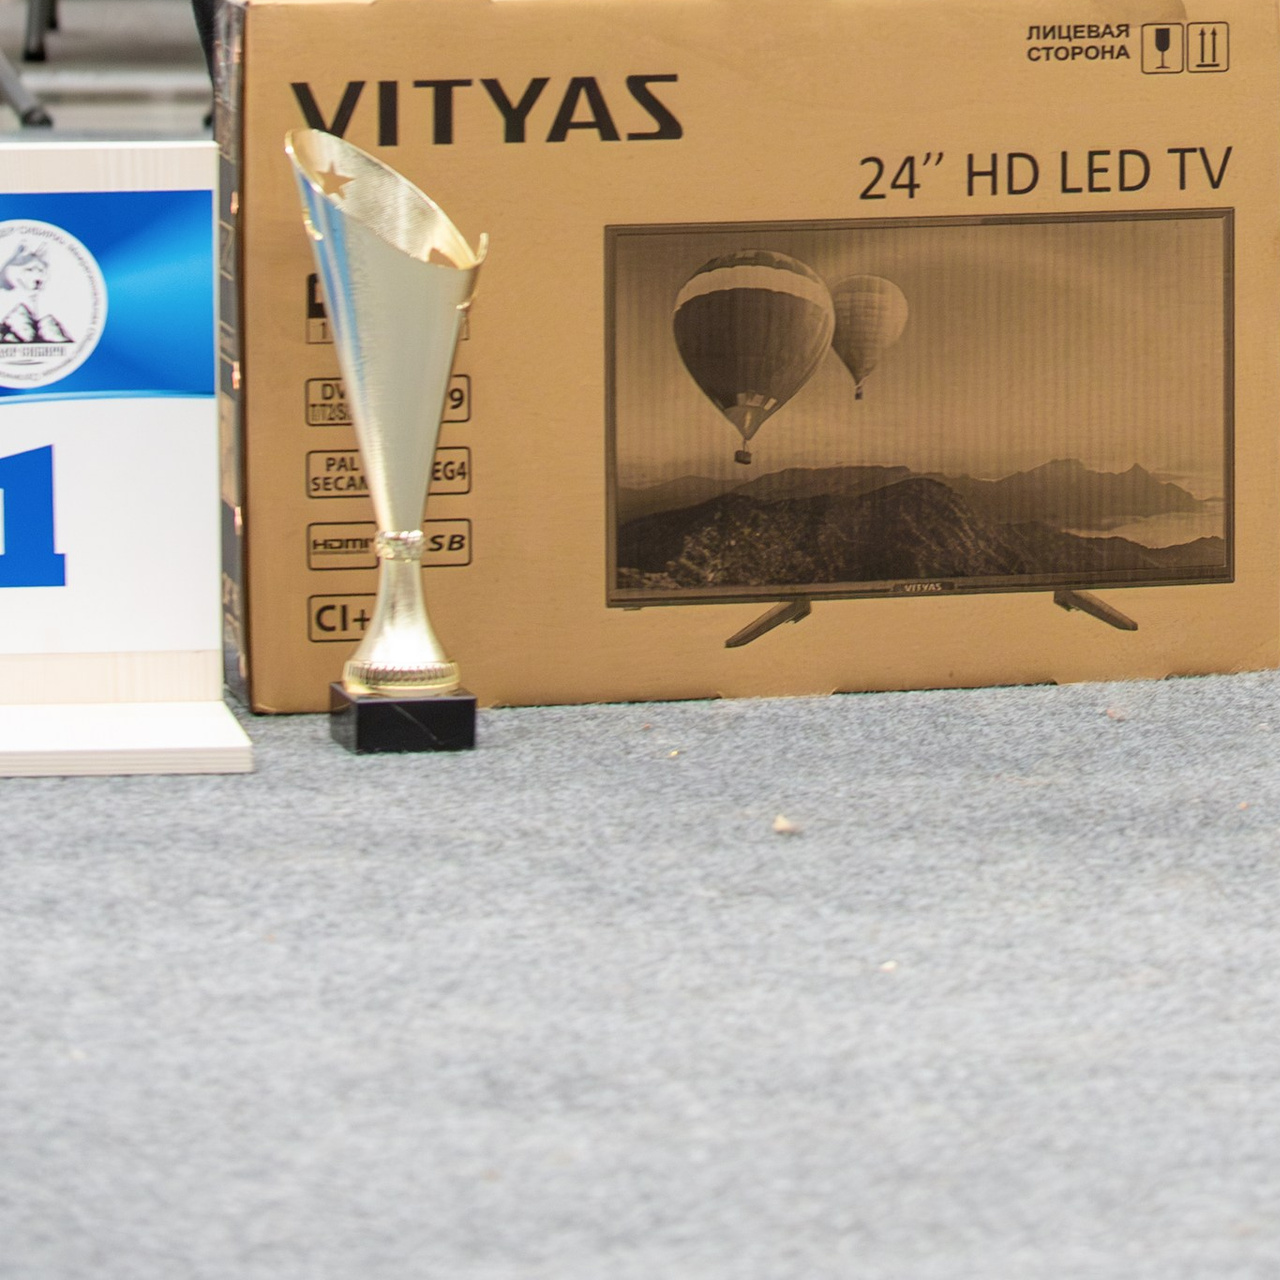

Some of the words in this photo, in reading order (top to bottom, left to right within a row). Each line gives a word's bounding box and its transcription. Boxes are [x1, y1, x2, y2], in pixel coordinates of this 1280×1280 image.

[1026, 23, 1130, 42] ЛИЦЕВАЯ
[1027, 45, 1130, 61] СТОРОНА
[291, 74, 684, 146] VITYAS
[967, 152, 1040, 196] HD
[1061, 149, 1151, 194] LED
[1167, 146, 1233, 190] TV
[321, 383, 346, 400] DV
[449, 388, 464, 409] 9
[326, 457, 359, 472] PAL
[432, 461, 467, 481] EG4
[0, 444, 67, 587] 1
[428, 534, 466, 551] SB
[904, 582, 943, 592] VITYAS
[315, 604, 371, 631] CI+
